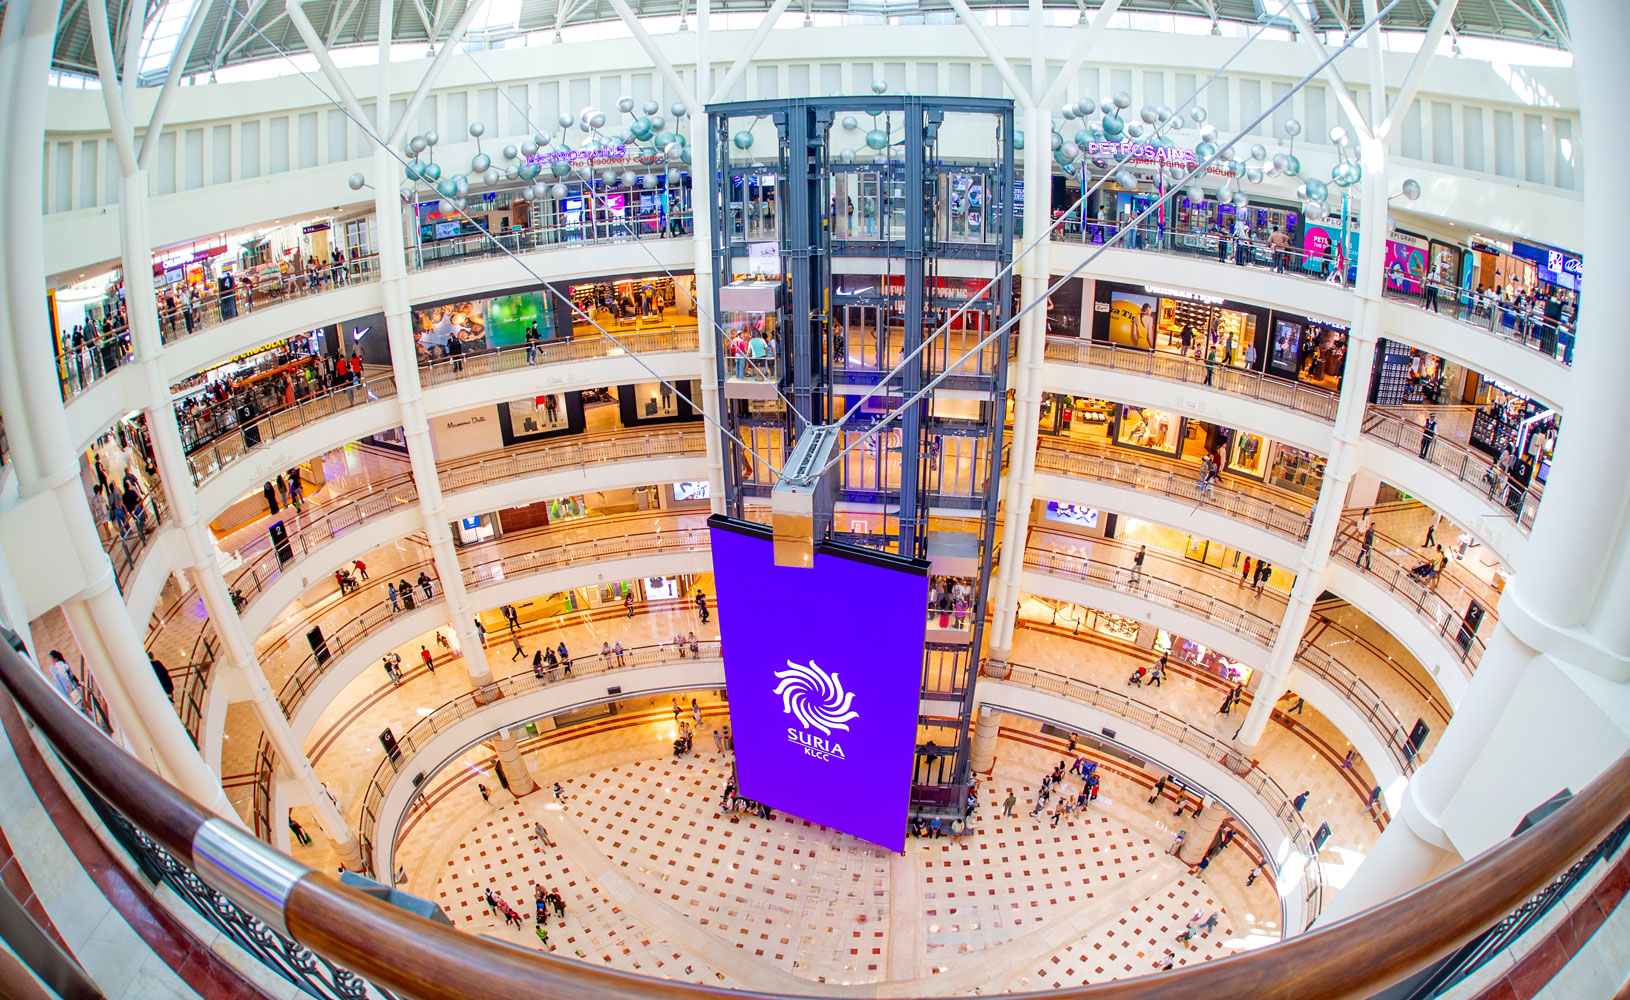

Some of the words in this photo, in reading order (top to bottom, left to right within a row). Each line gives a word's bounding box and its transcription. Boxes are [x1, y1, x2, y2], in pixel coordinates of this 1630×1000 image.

[526, 145, 627, 167] PETROSAINS
[1088, 142, 1195, 162] PETROSAINS
[587, 156, 631, 167] Discovery
[1159, 159, 1185, 170] Sains
[224, 278, 231, 288] 4
[244, 407, 251, 417] 3
[1519, 464, 1526, 476] 3
[276, 526, 282, 535] 2
[1470, 606, 1478, 618] 2
[1418, 726, 1423, 735] 1
[384, 733, 391, 741] G
[787, 727, 846, 757] SURIA
[804, 747, 830, 762] KLCC
